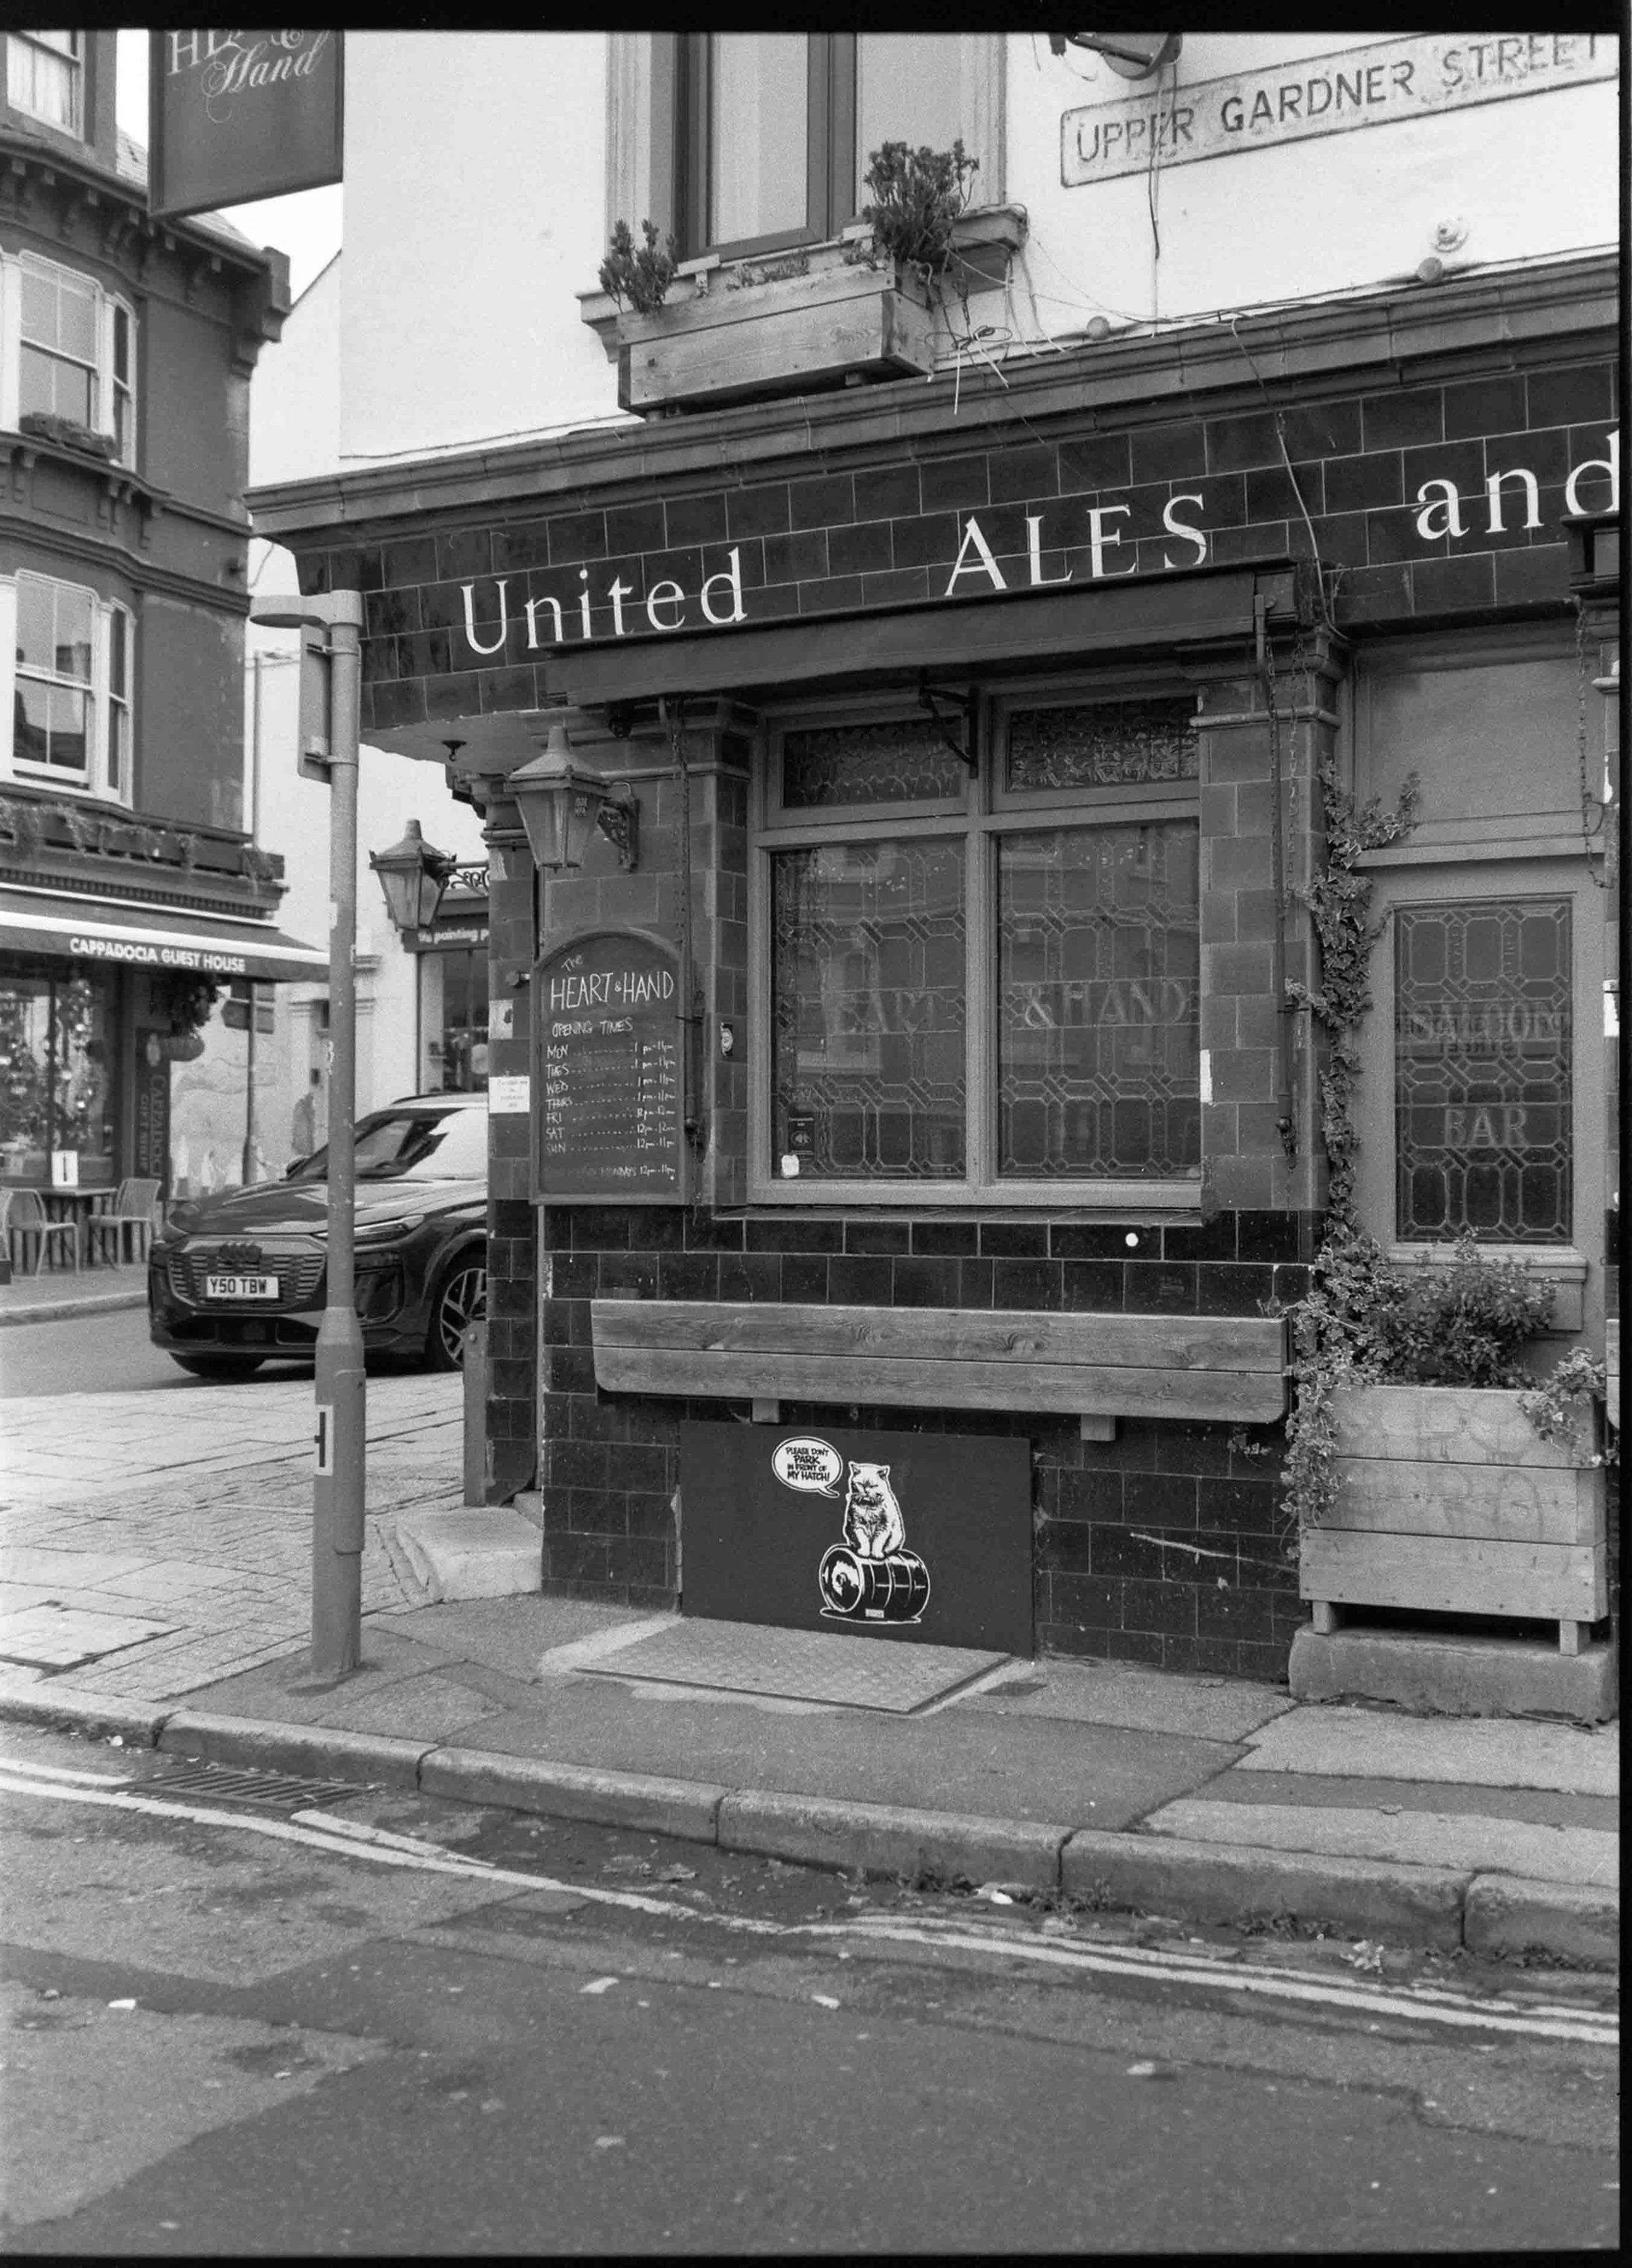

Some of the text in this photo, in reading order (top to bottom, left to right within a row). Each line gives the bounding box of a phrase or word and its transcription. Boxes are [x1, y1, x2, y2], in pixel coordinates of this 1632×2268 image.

[201, 31, 330, 123] Hand
[1076, 32, 1597, 163] UPPER GARDNER STREET
[461, 428, 1620, 654] United ALES and
[70, 937, 245, 972] CAPPADOCIA GUEST HOUSE
[551, 971, 674, 1011] HEART & HAND
[552, 1016, 633, 1037] OPENING TIMES
[547, 1045, 568, 1059] MON
[546, 1062, 569, 1079] TUES
[546, 1079, 569, 1096] WED
[546, 1112, 562, 1124] FRI
[1445, 1109, 1528, 1144] BAR
[546, 1127, 565, 1140] SAT
[546, 1142, 565, 1156] SUN
[210, 1278, 267, 1294] Y50 TBW
[786, 1447, 828, 1457] PLEASE DON'T
[793, 1455, 821, 1464] PARK
[787, 1471, 830, 1482] MY HATCH!
